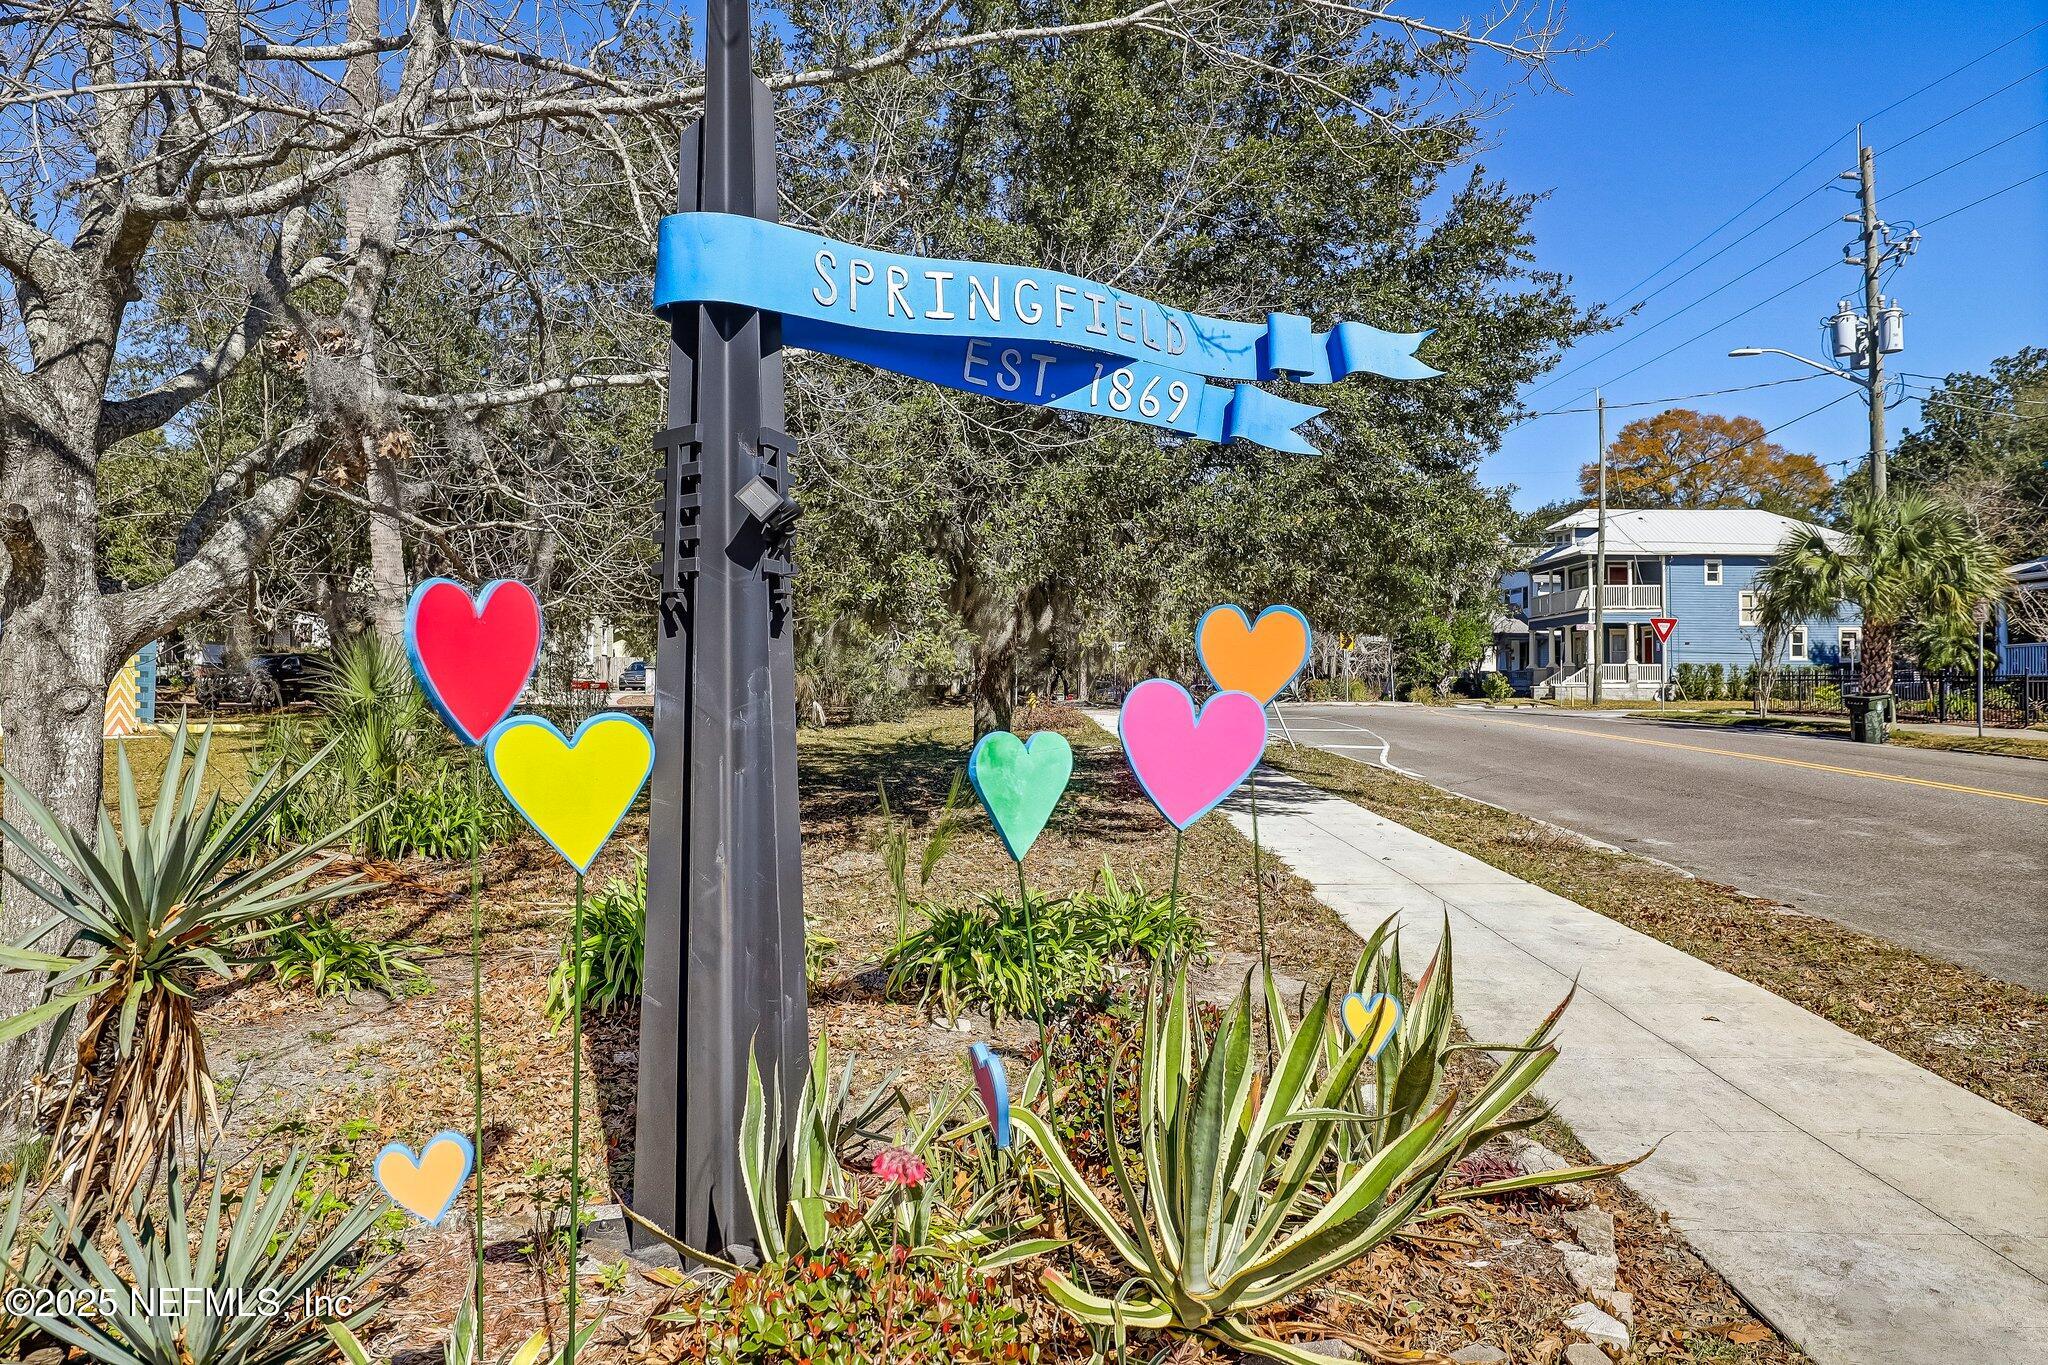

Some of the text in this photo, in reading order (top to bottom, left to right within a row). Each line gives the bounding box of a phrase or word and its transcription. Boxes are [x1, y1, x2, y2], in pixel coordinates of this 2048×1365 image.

[812, 250, 1188, 355] SPRINGFIELD
[963, 338, 1190, 423] EST. 1869
